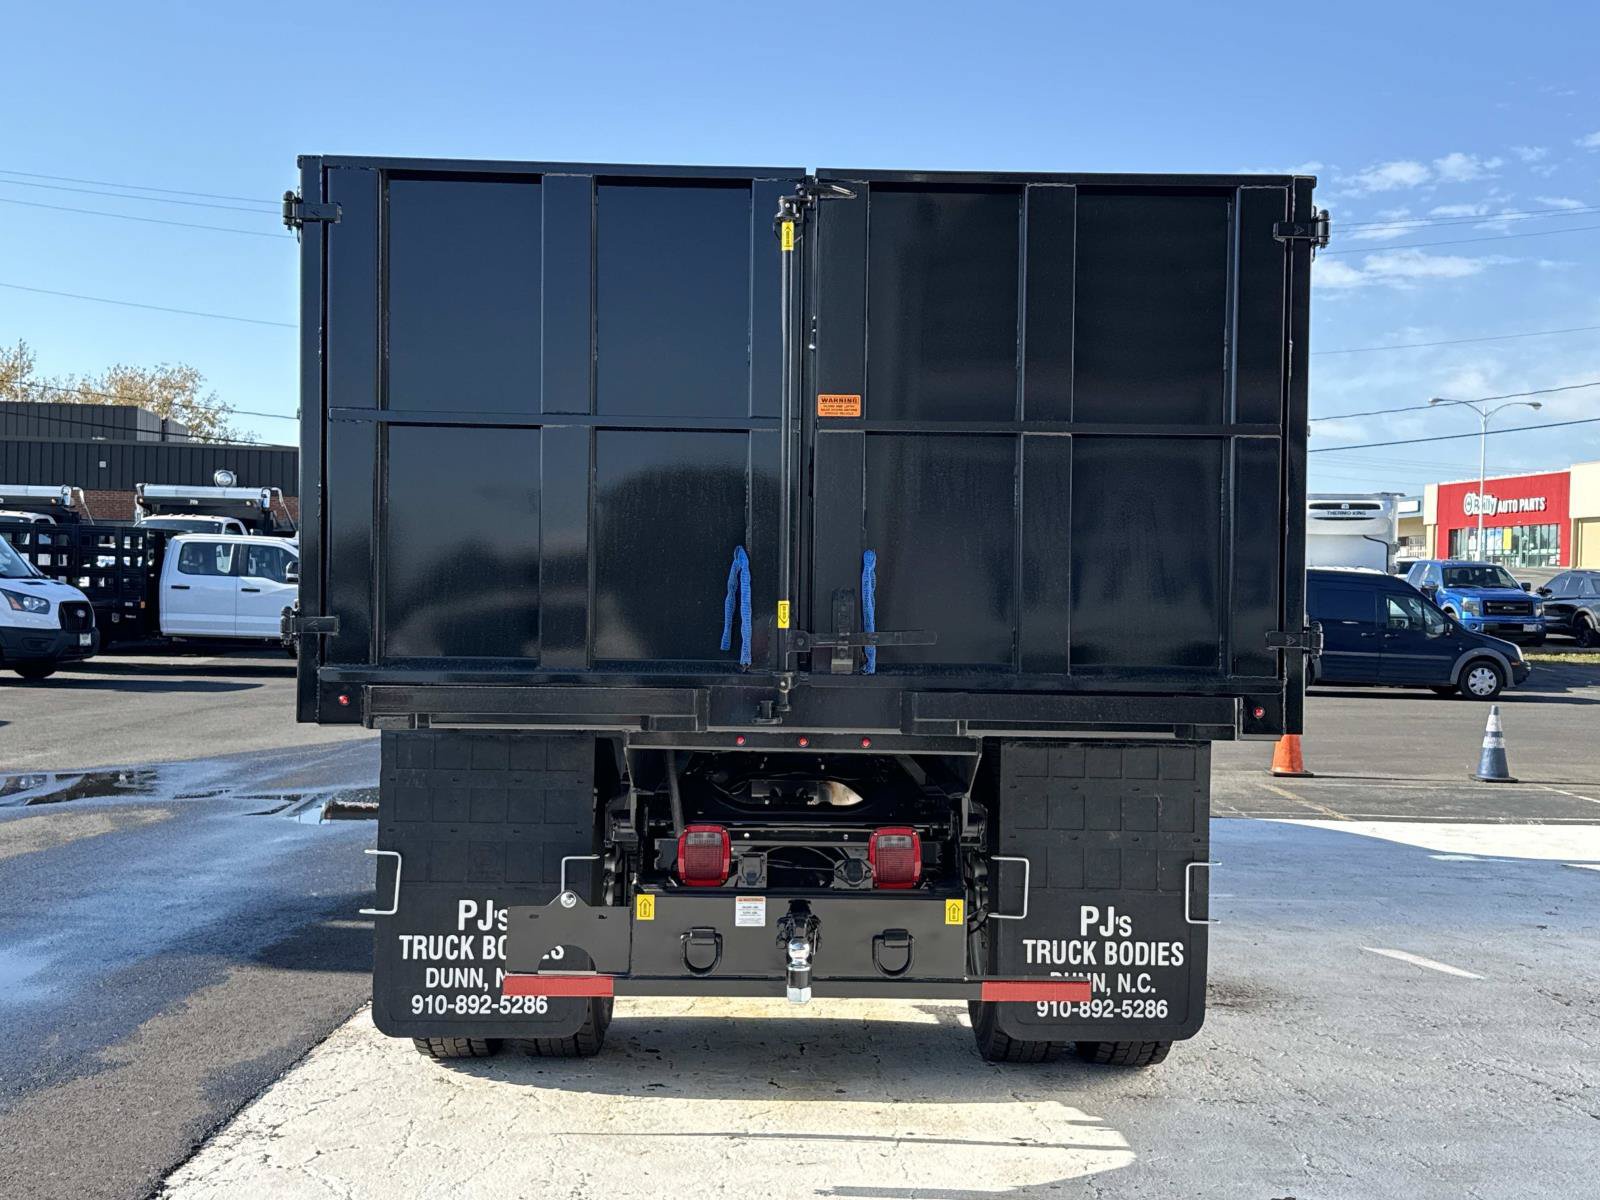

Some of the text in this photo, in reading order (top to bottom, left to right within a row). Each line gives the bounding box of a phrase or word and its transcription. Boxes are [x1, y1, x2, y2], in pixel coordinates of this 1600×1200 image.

[1497, 499, 1519, 513] AUTO
[1519, 496, 1546, 511] PARTS
[1080, 905, 1132, 937] PJ's
[399, 935, 475, 960] TRUCK
[1022, 939, 1184, 966] TRUCK BODIES
[425, 967, 489, 992] DUNN,
[1117, 972, 1156, 994] N.C.
[411, 994, 548, 1015] 910-892-5286
[1036, 999, 1168, 1019] 910-892-5286
